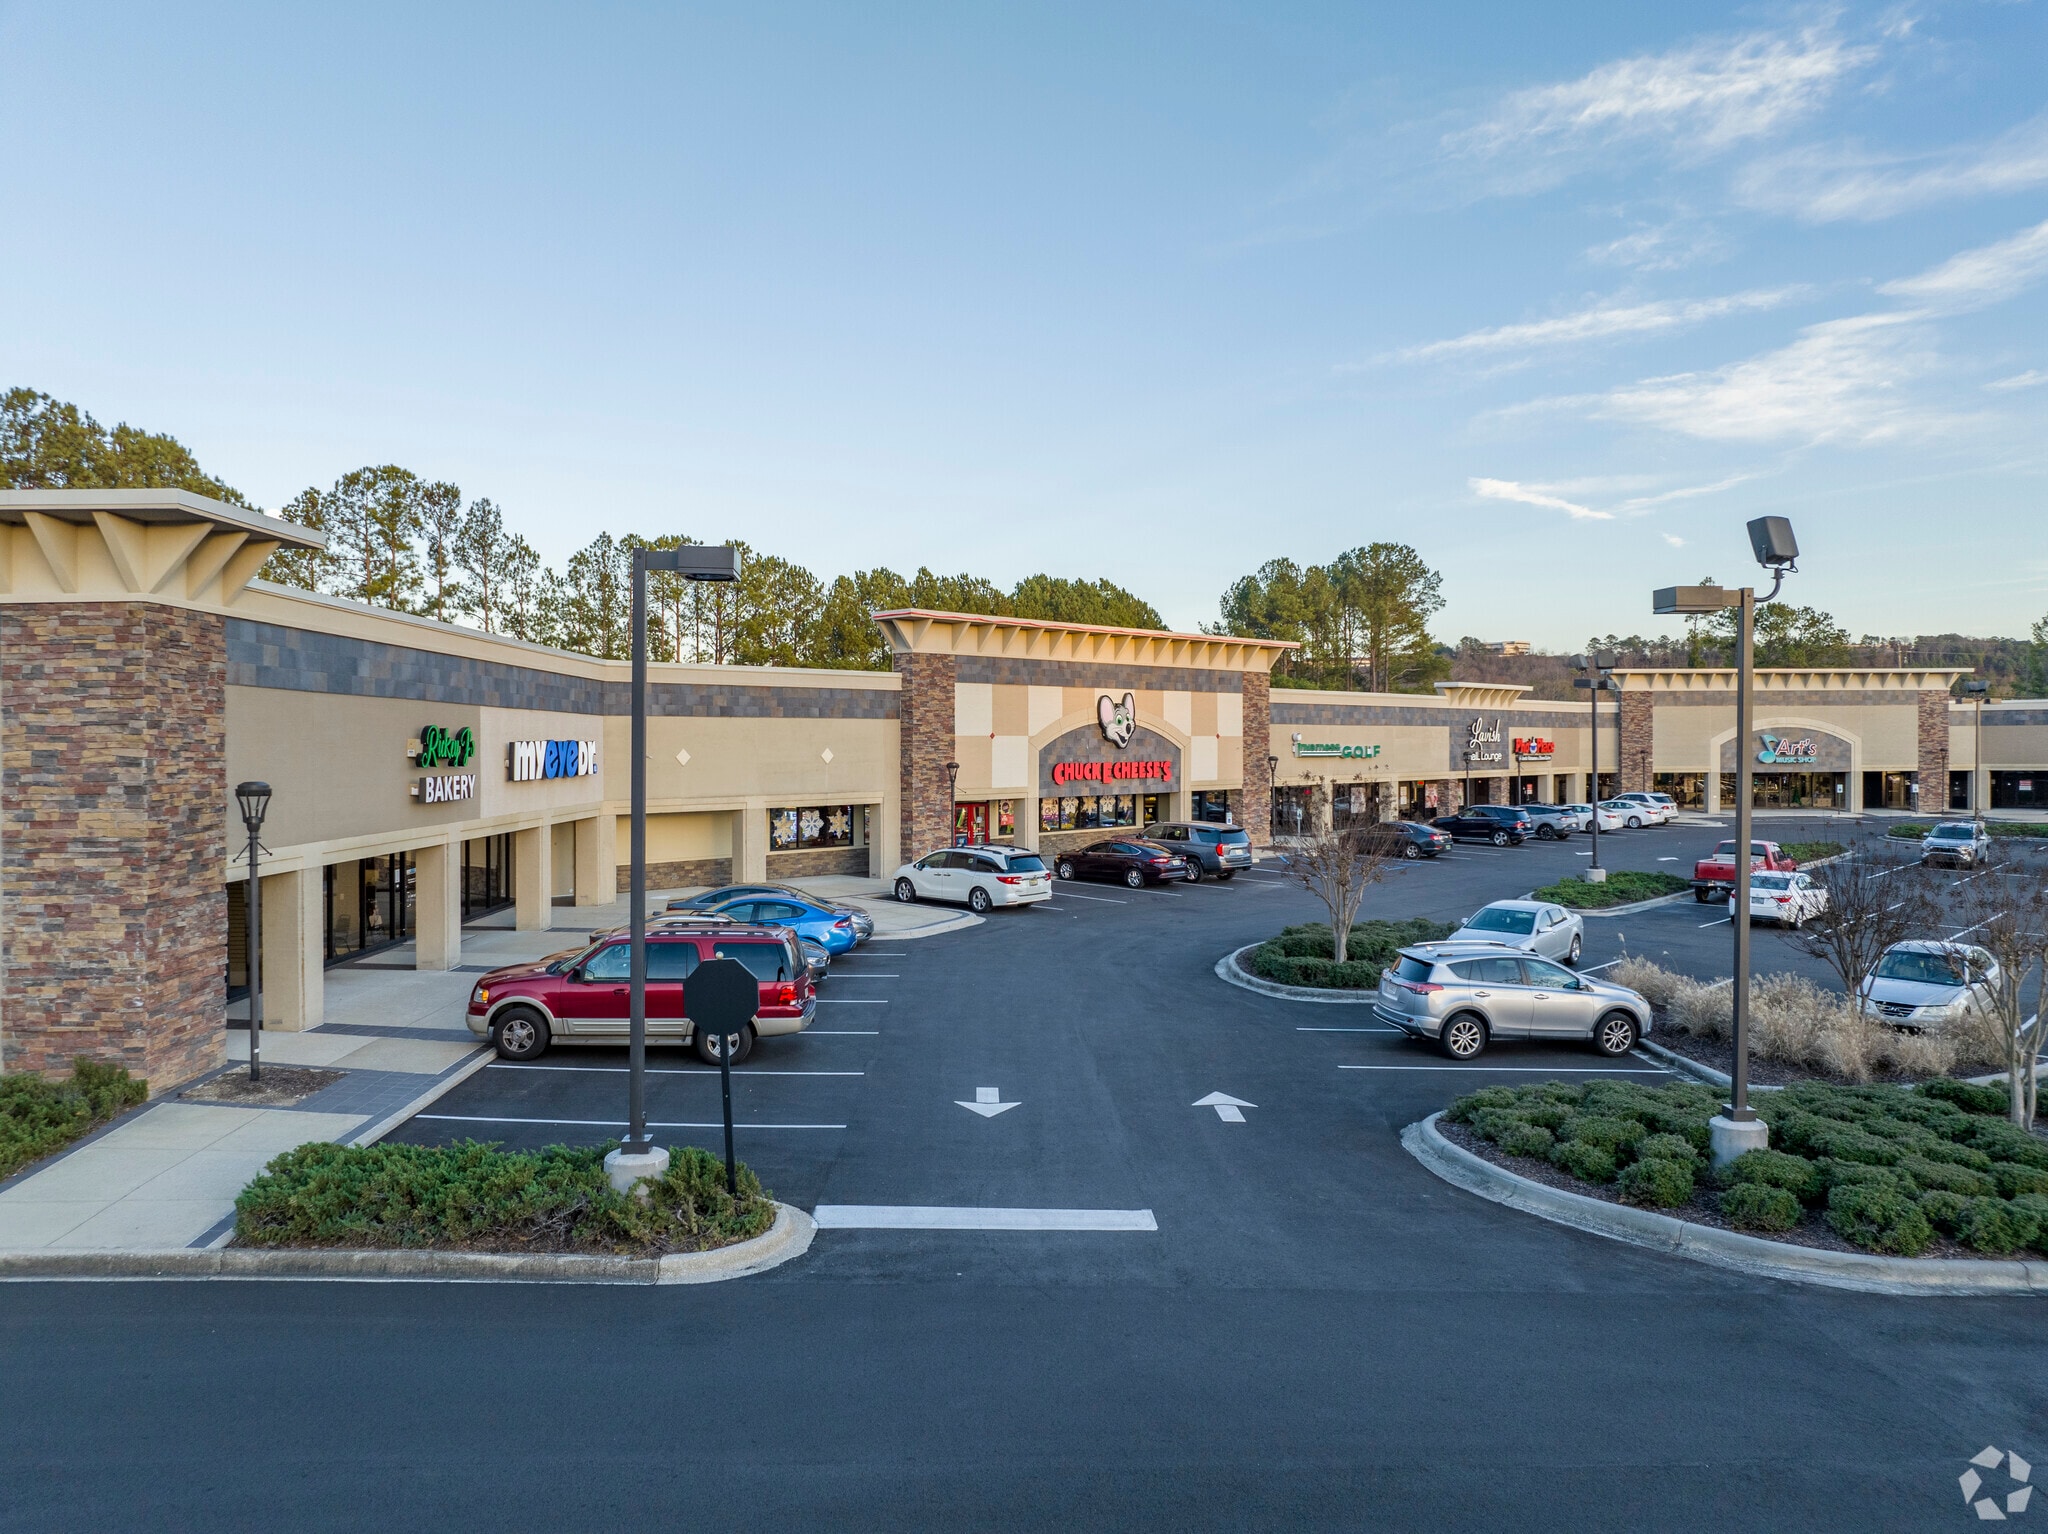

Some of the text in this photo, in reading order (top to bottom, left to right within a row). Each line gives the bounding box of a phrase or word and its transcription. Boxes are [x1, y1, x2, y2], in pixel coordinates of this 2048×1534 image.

[1469, 717, 1501, 750] Lavish
[1341, 745, 1381, 759] GOLF
[1774, 738, 1818, 756] Art's
[1481, 752, 1502, 762] Lounge
[1775, 756, 1797, 764] MUSIC
[1053, 761, 1172, 785] CHUCK E CHEESE'S
[425, 774, 476, 803] BAKERY
